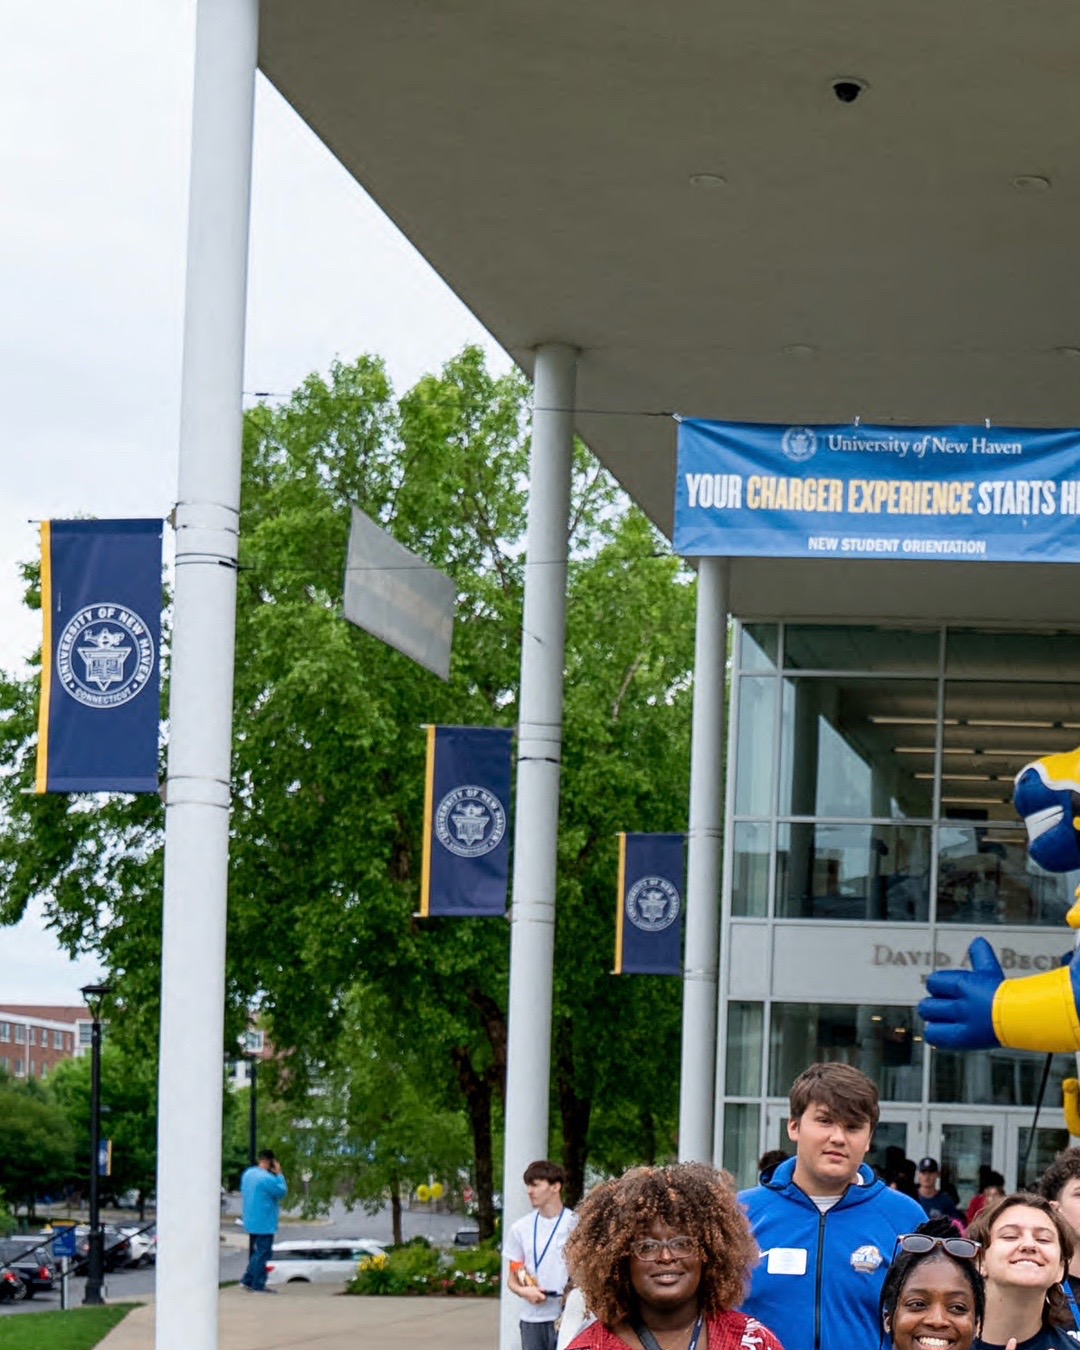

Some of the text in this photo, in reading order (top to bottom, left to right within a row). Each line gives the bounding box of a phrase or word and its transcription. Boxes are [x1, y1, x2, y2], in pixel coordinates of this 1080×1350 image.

[829, 434, 1022, 457] University of New Haven
[685, 473, 743, 509] YOUR
[746, 475, 843, 513] CHARGER
[847, 478, 975, 516] EXPERIENCE
[977, 480, 1056, 516] STARTS
[807, 537, 986, 555] NEW STUDENT ORIENTATION
[60, 607, 151, 683] UNIVERSITY OF NEW HAVEN
[74, 687, 131, 704] CONNECTICUT
